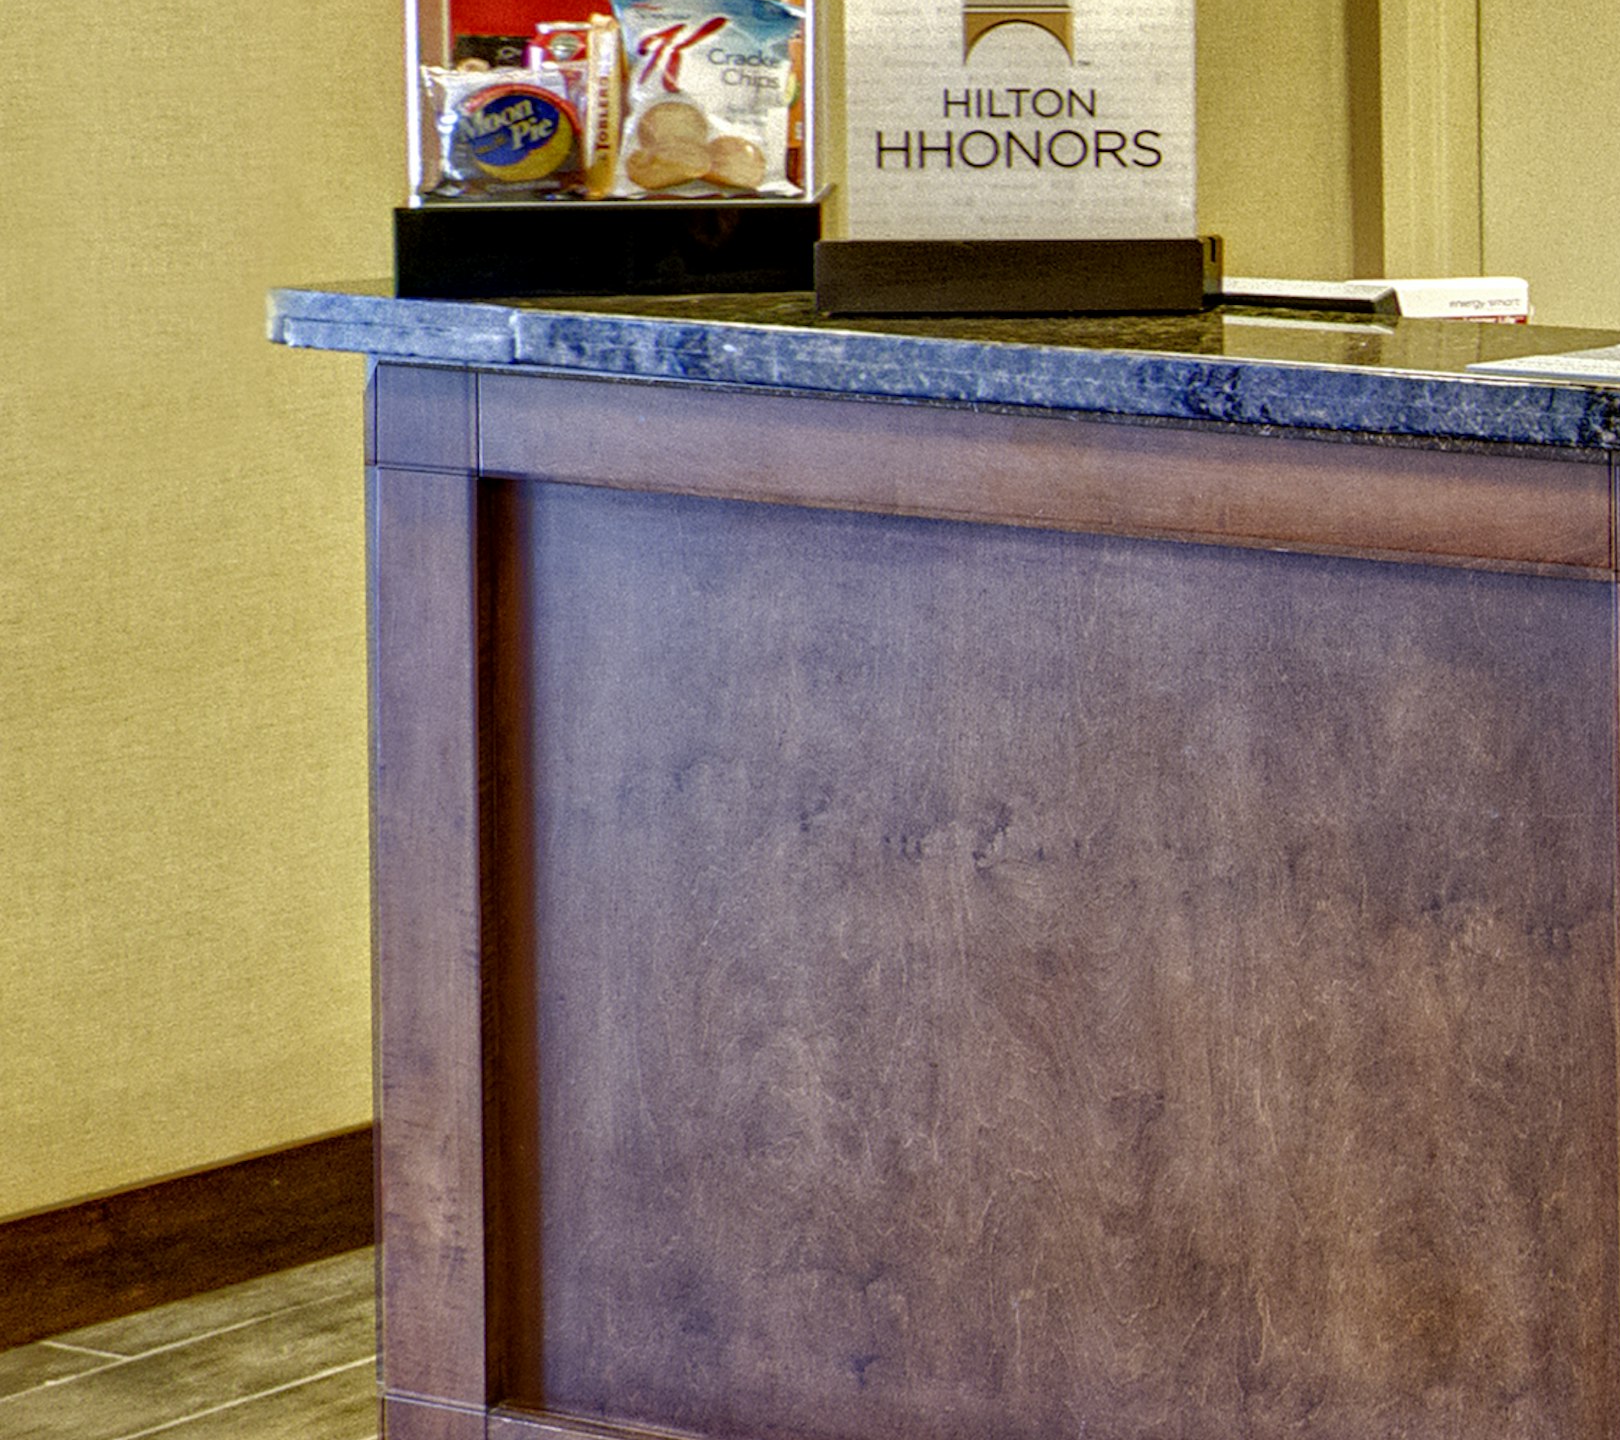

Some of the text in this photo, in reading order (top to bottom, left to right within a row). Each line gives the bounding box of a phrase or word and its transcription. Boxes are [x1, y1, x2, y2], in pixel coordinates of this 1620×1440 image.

[720, 69, 781, 95] Chips
[458, 98, 534, 141] Moon
[943, 87, 1097, 119] HILTON
[508, 116, 555, 151] Pie
[875, 129, 1163, 169] HHONORS
